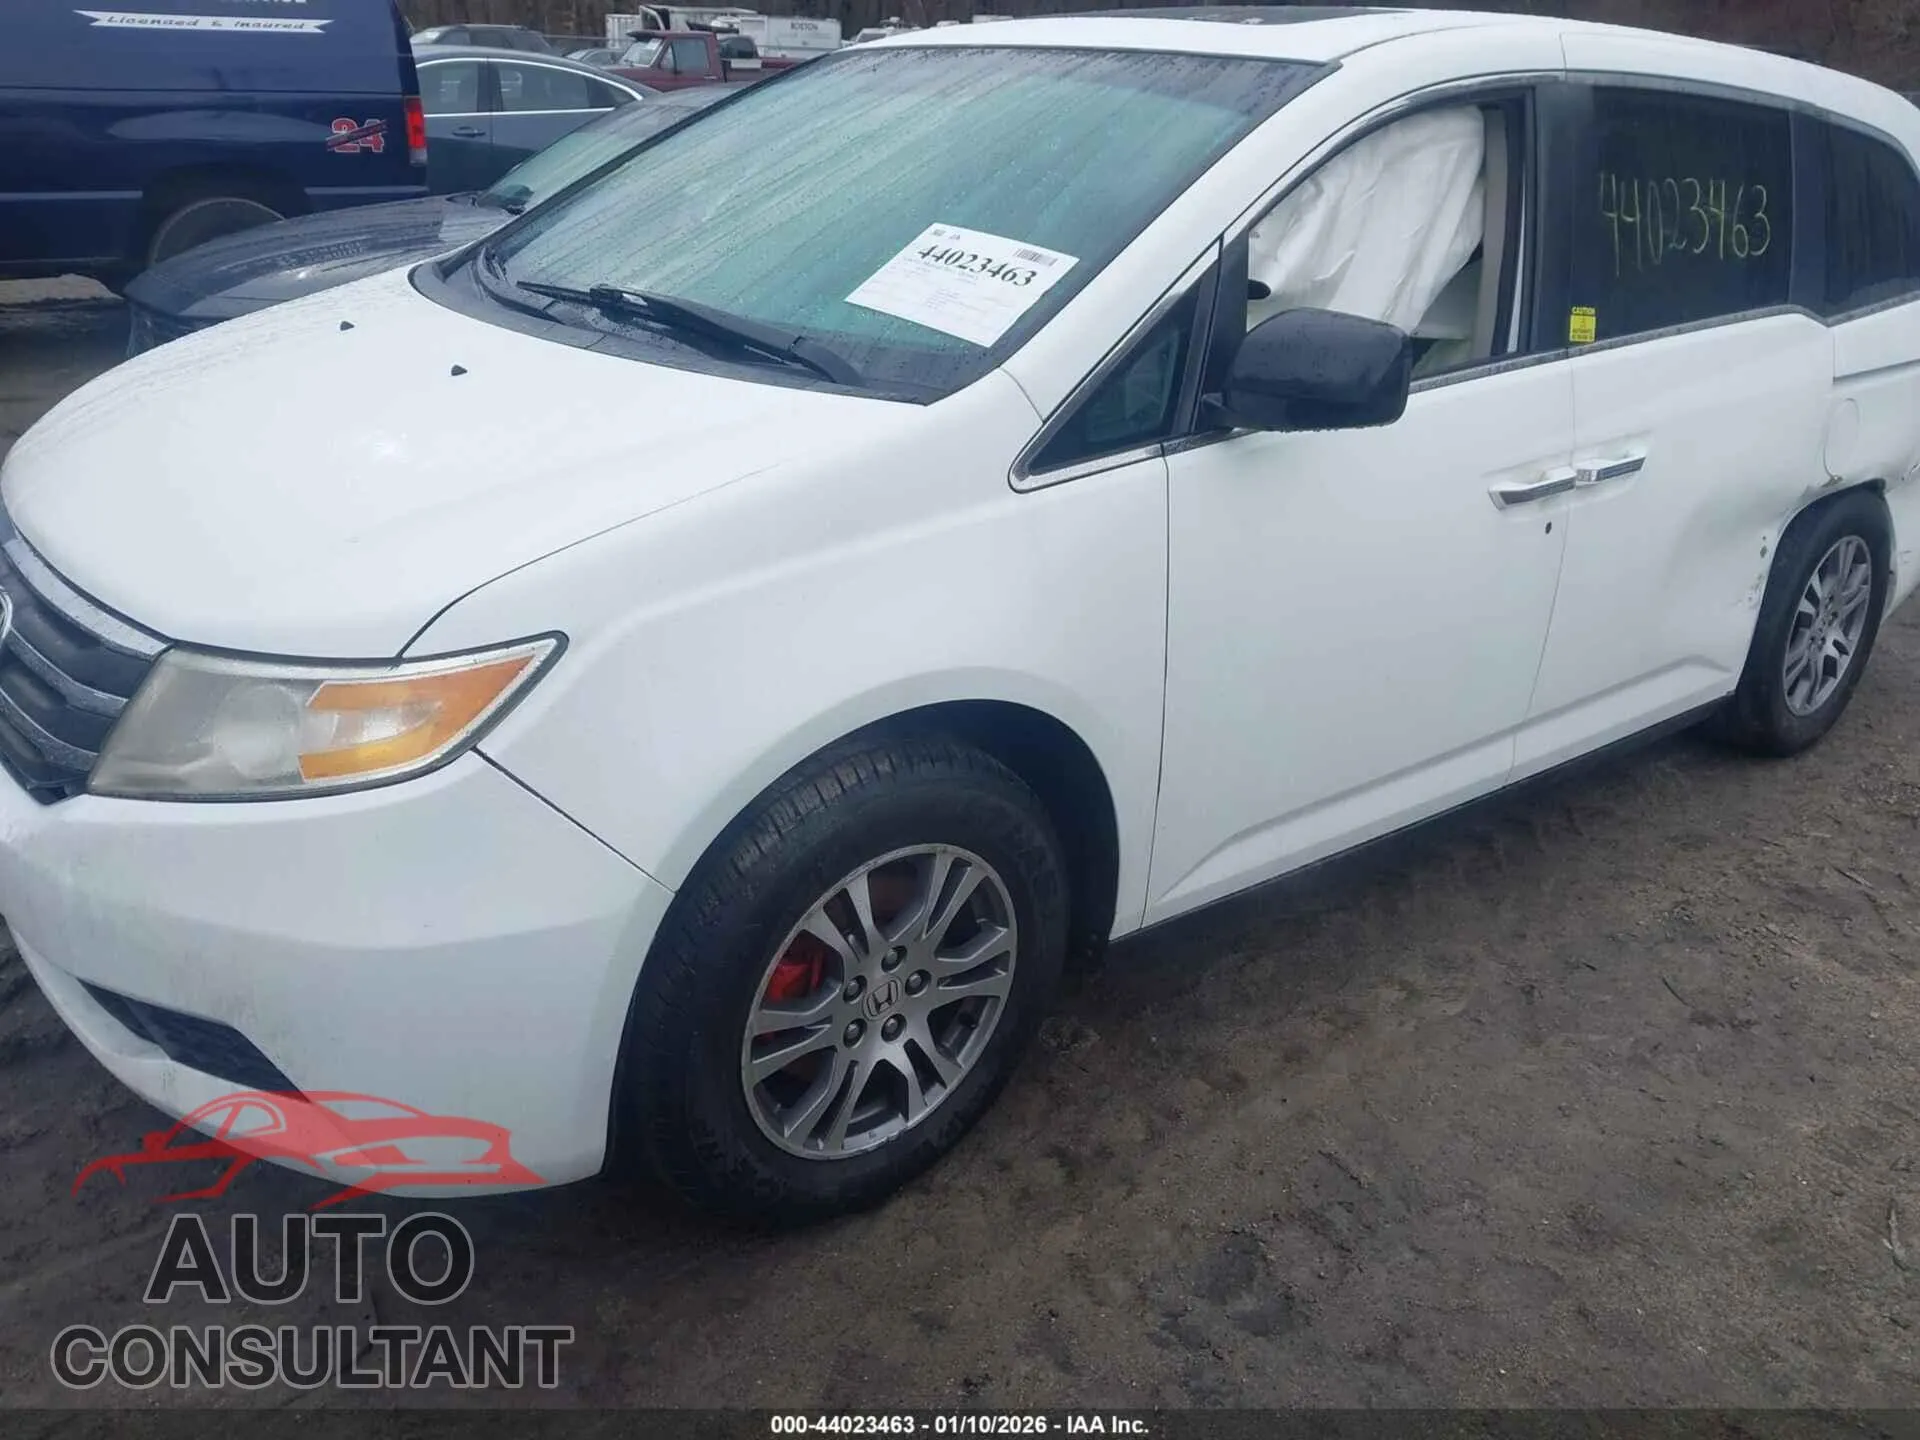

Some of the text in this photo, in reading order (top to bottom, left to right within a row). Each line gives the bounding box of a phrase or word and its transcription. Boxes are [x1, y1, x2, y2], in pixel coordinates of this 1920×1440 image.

[106, 15, 200, 27] Licensed
[1600, 172, 1771, 278] 44023463
[917, 244, 1038, 287] 44023463
